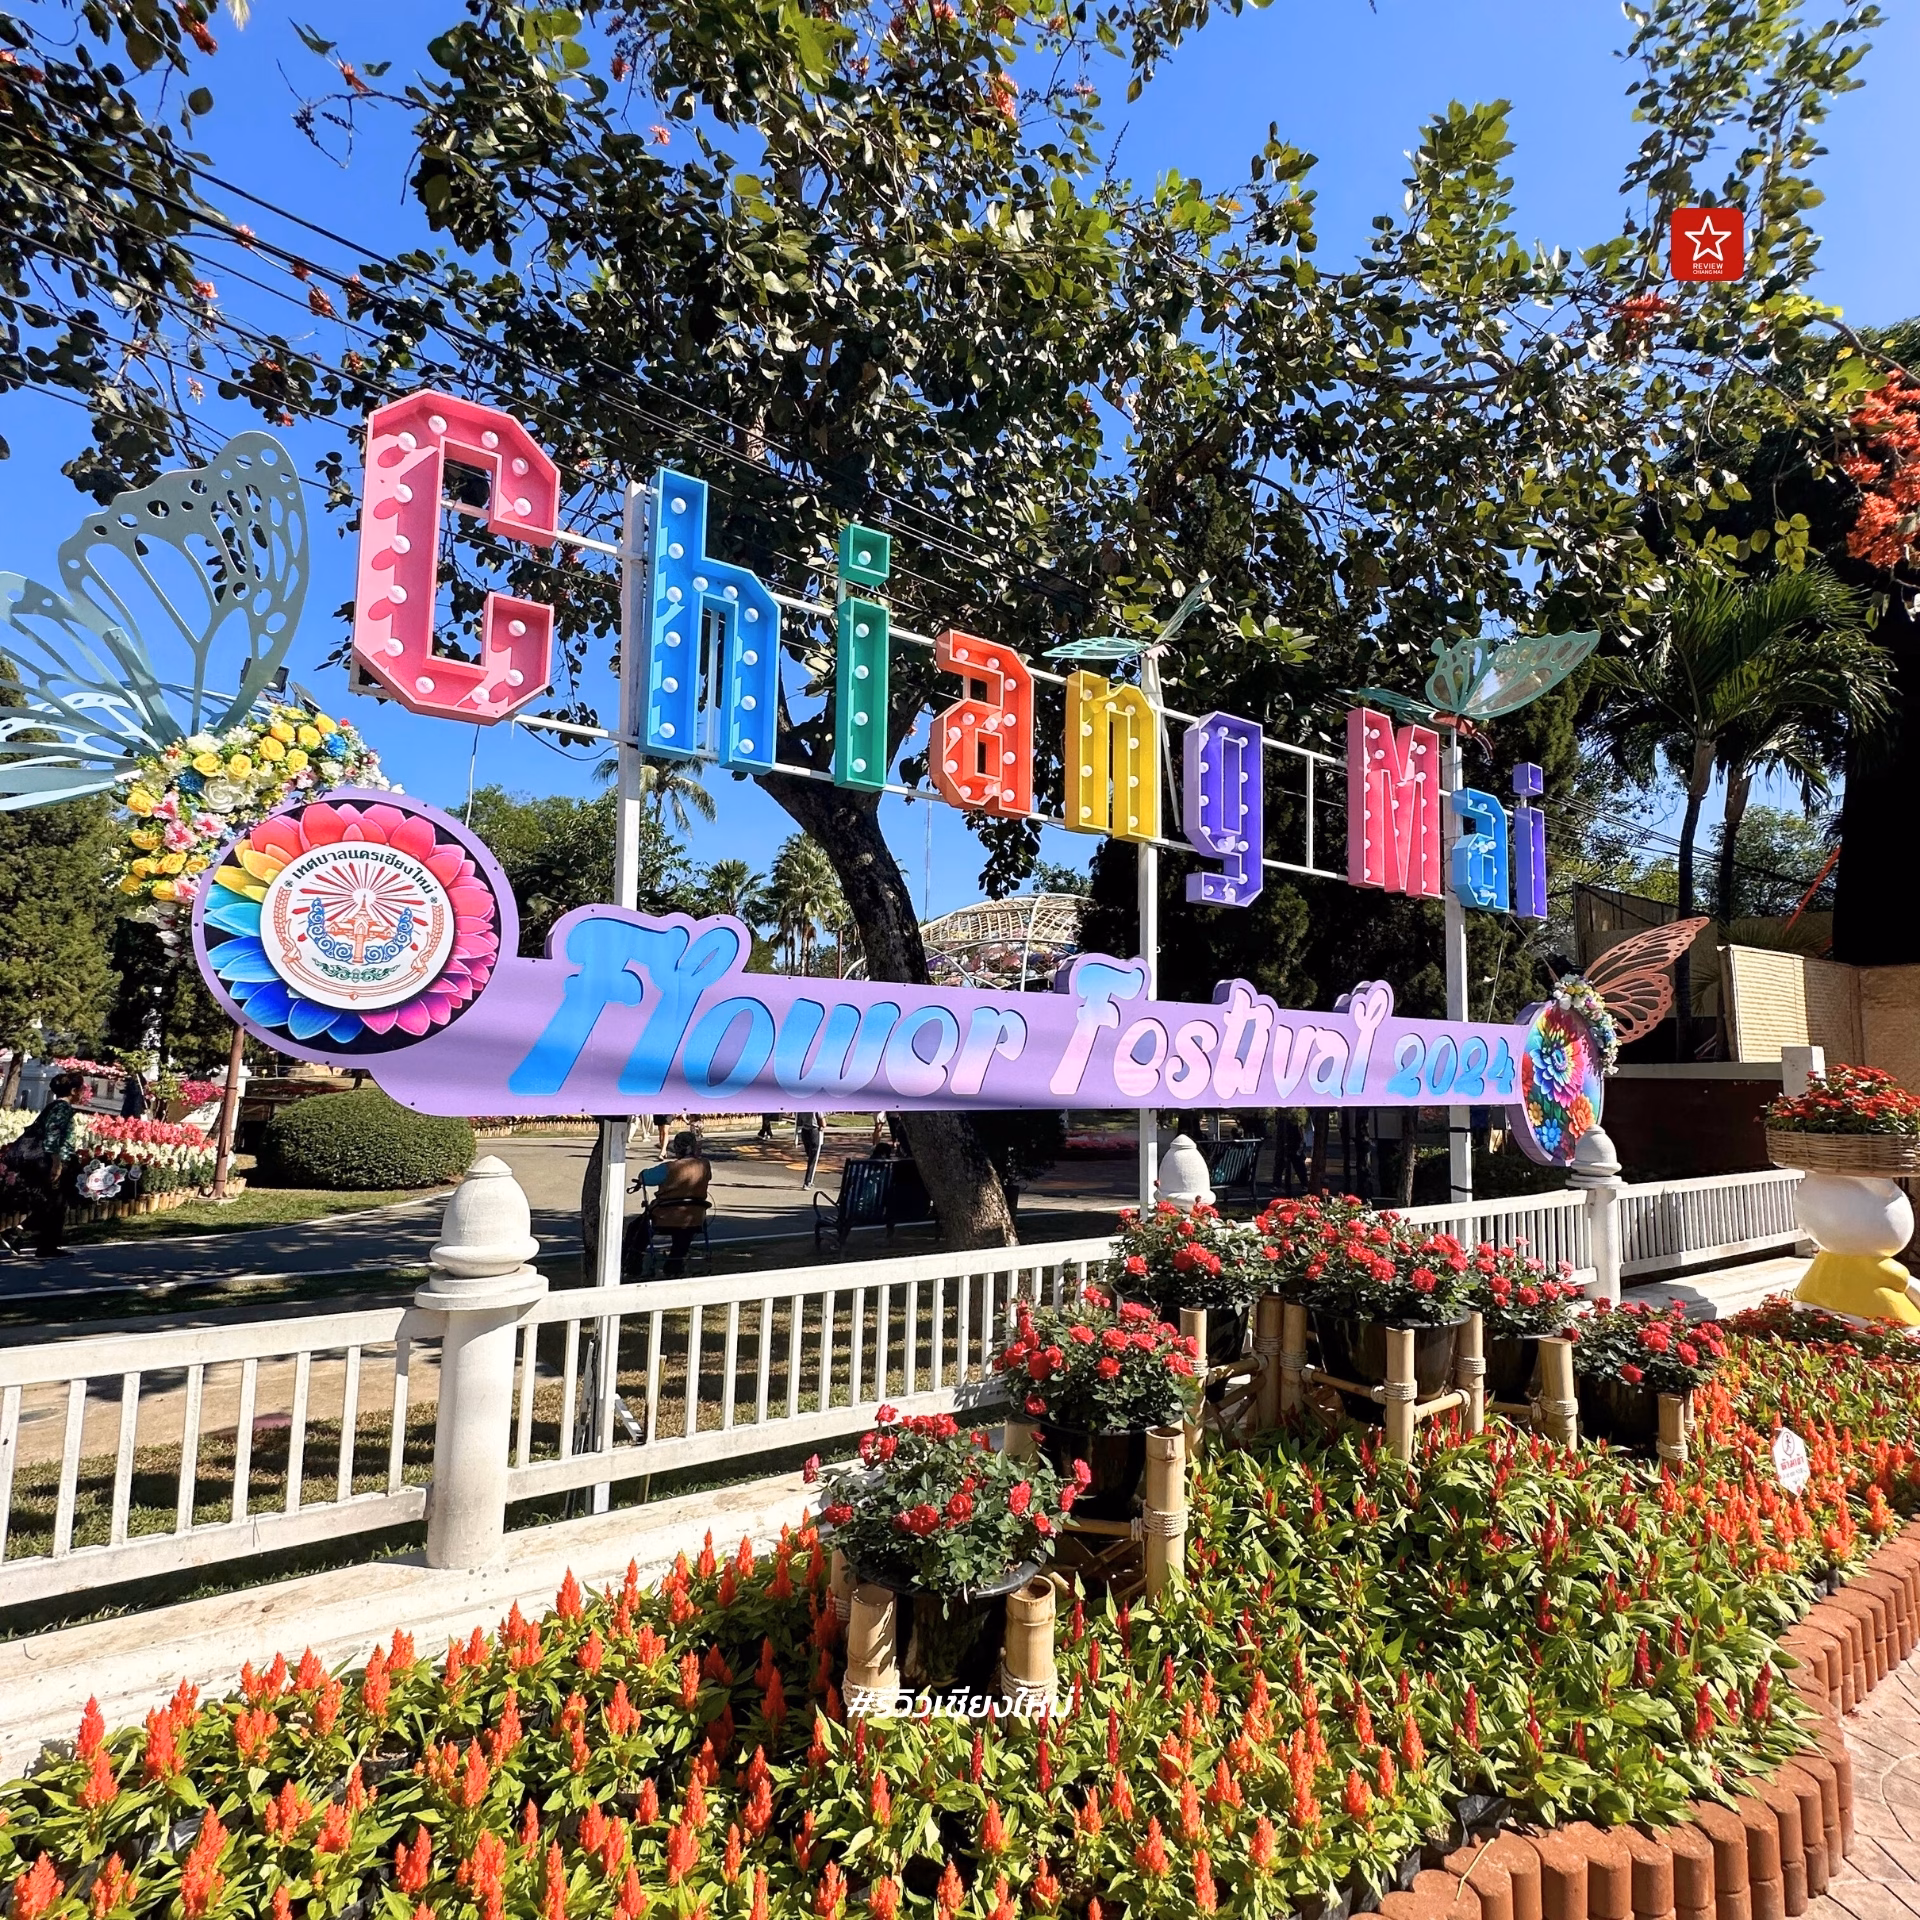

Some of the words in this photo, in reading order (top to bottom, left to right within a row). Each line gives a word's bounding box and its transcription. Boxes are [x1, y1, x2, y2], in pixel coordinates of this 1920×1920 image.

[352, 388, 1263, 907] Chiang
[1347, 706, 1548, 919] Mai
[292, 849, 438, 895] เทศบาลนครเชียงใหม่
[507, 916, 1028, 1099] Flower
[1049, 962, 1393, 1100] Festival
[1387, 1031, 1516, 1099] 2024
